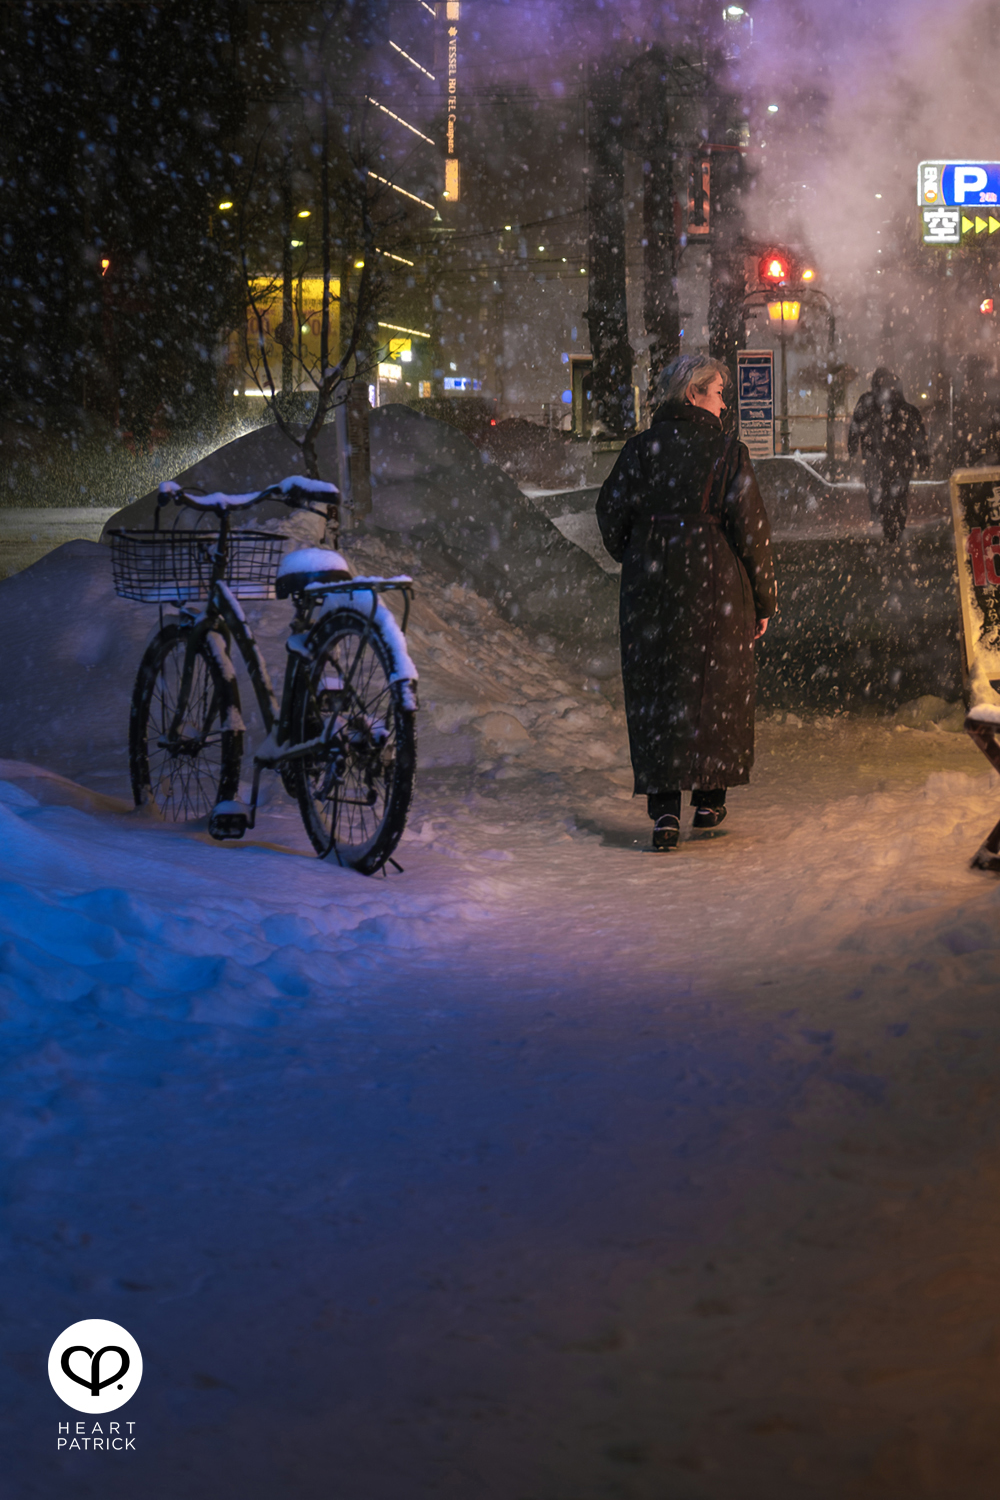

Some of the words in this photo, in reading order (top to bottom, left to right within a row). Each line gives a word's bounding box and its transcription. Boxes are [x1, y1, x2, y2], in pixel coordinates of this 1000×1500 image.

[447, 39, 458, 76] VESSEL
[954, 166, 988, 203] P
[923, 207, 960, 243] 空
